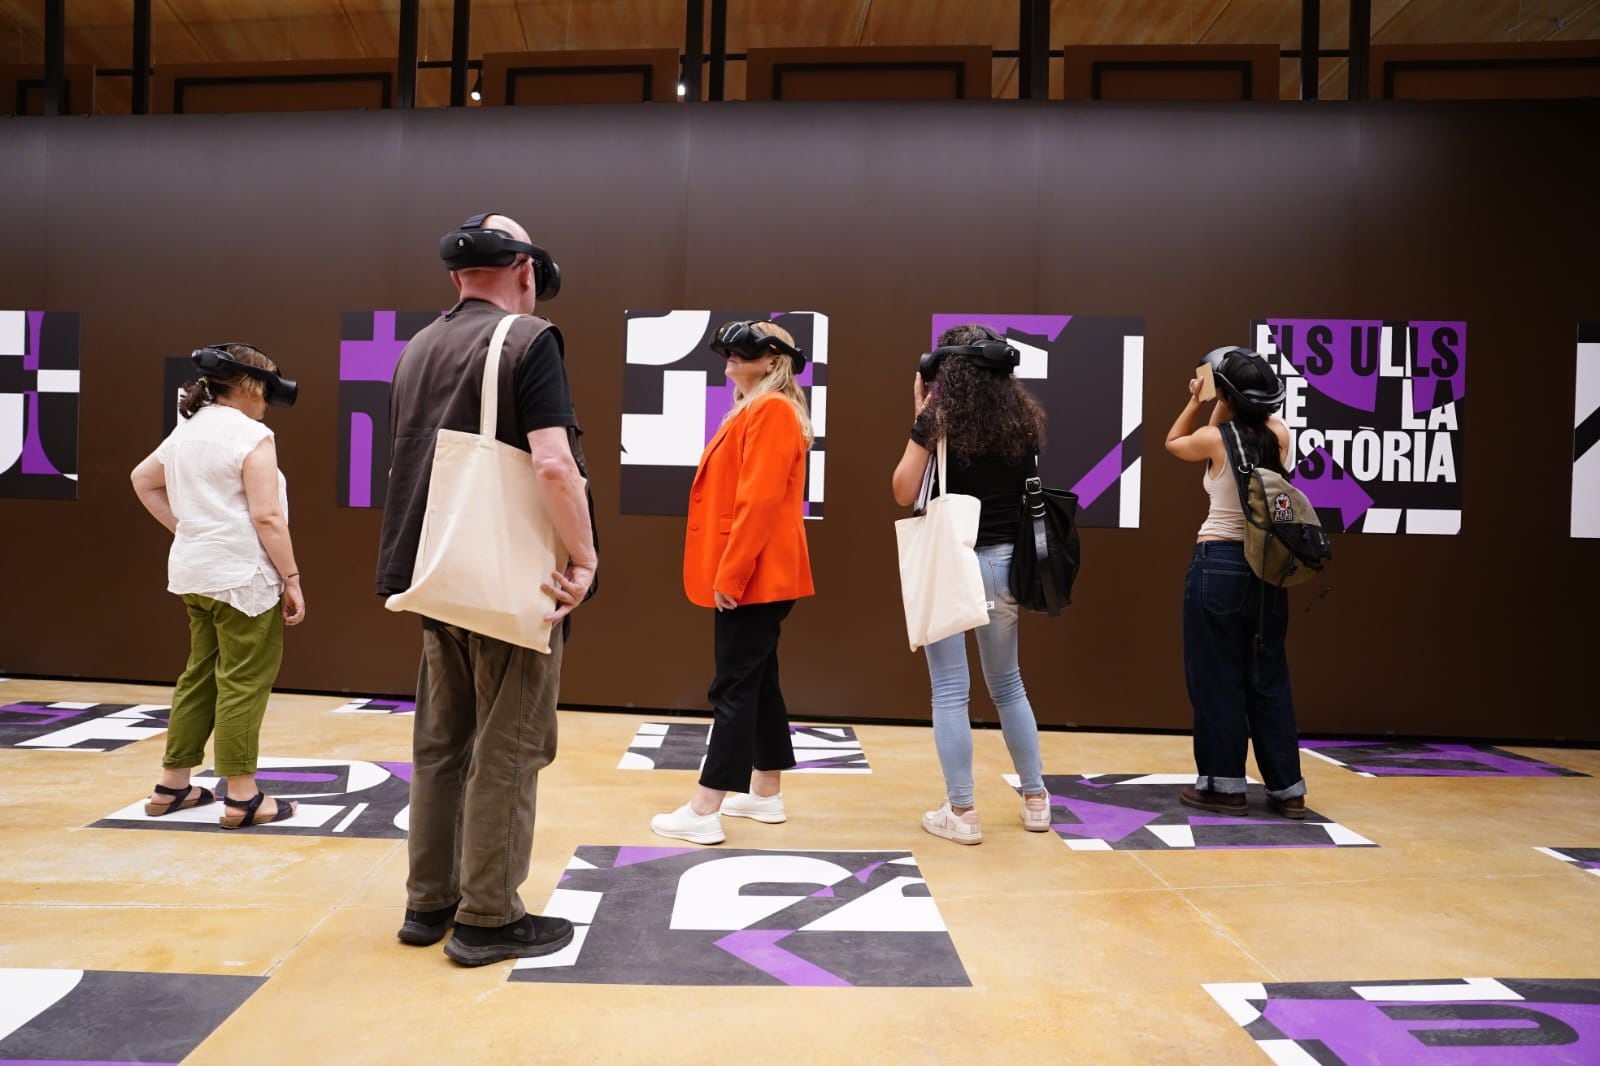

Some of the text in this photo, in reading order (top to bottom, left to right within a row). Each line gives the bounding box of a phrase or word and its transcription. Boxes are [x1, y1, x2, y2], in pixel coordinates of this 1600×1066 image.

[1257, 324, 1459, 378] ELS ULLS
[1271, 377, 1459, 430] E LA
[1288, 426, 1457, 483] ISTÒRIA
